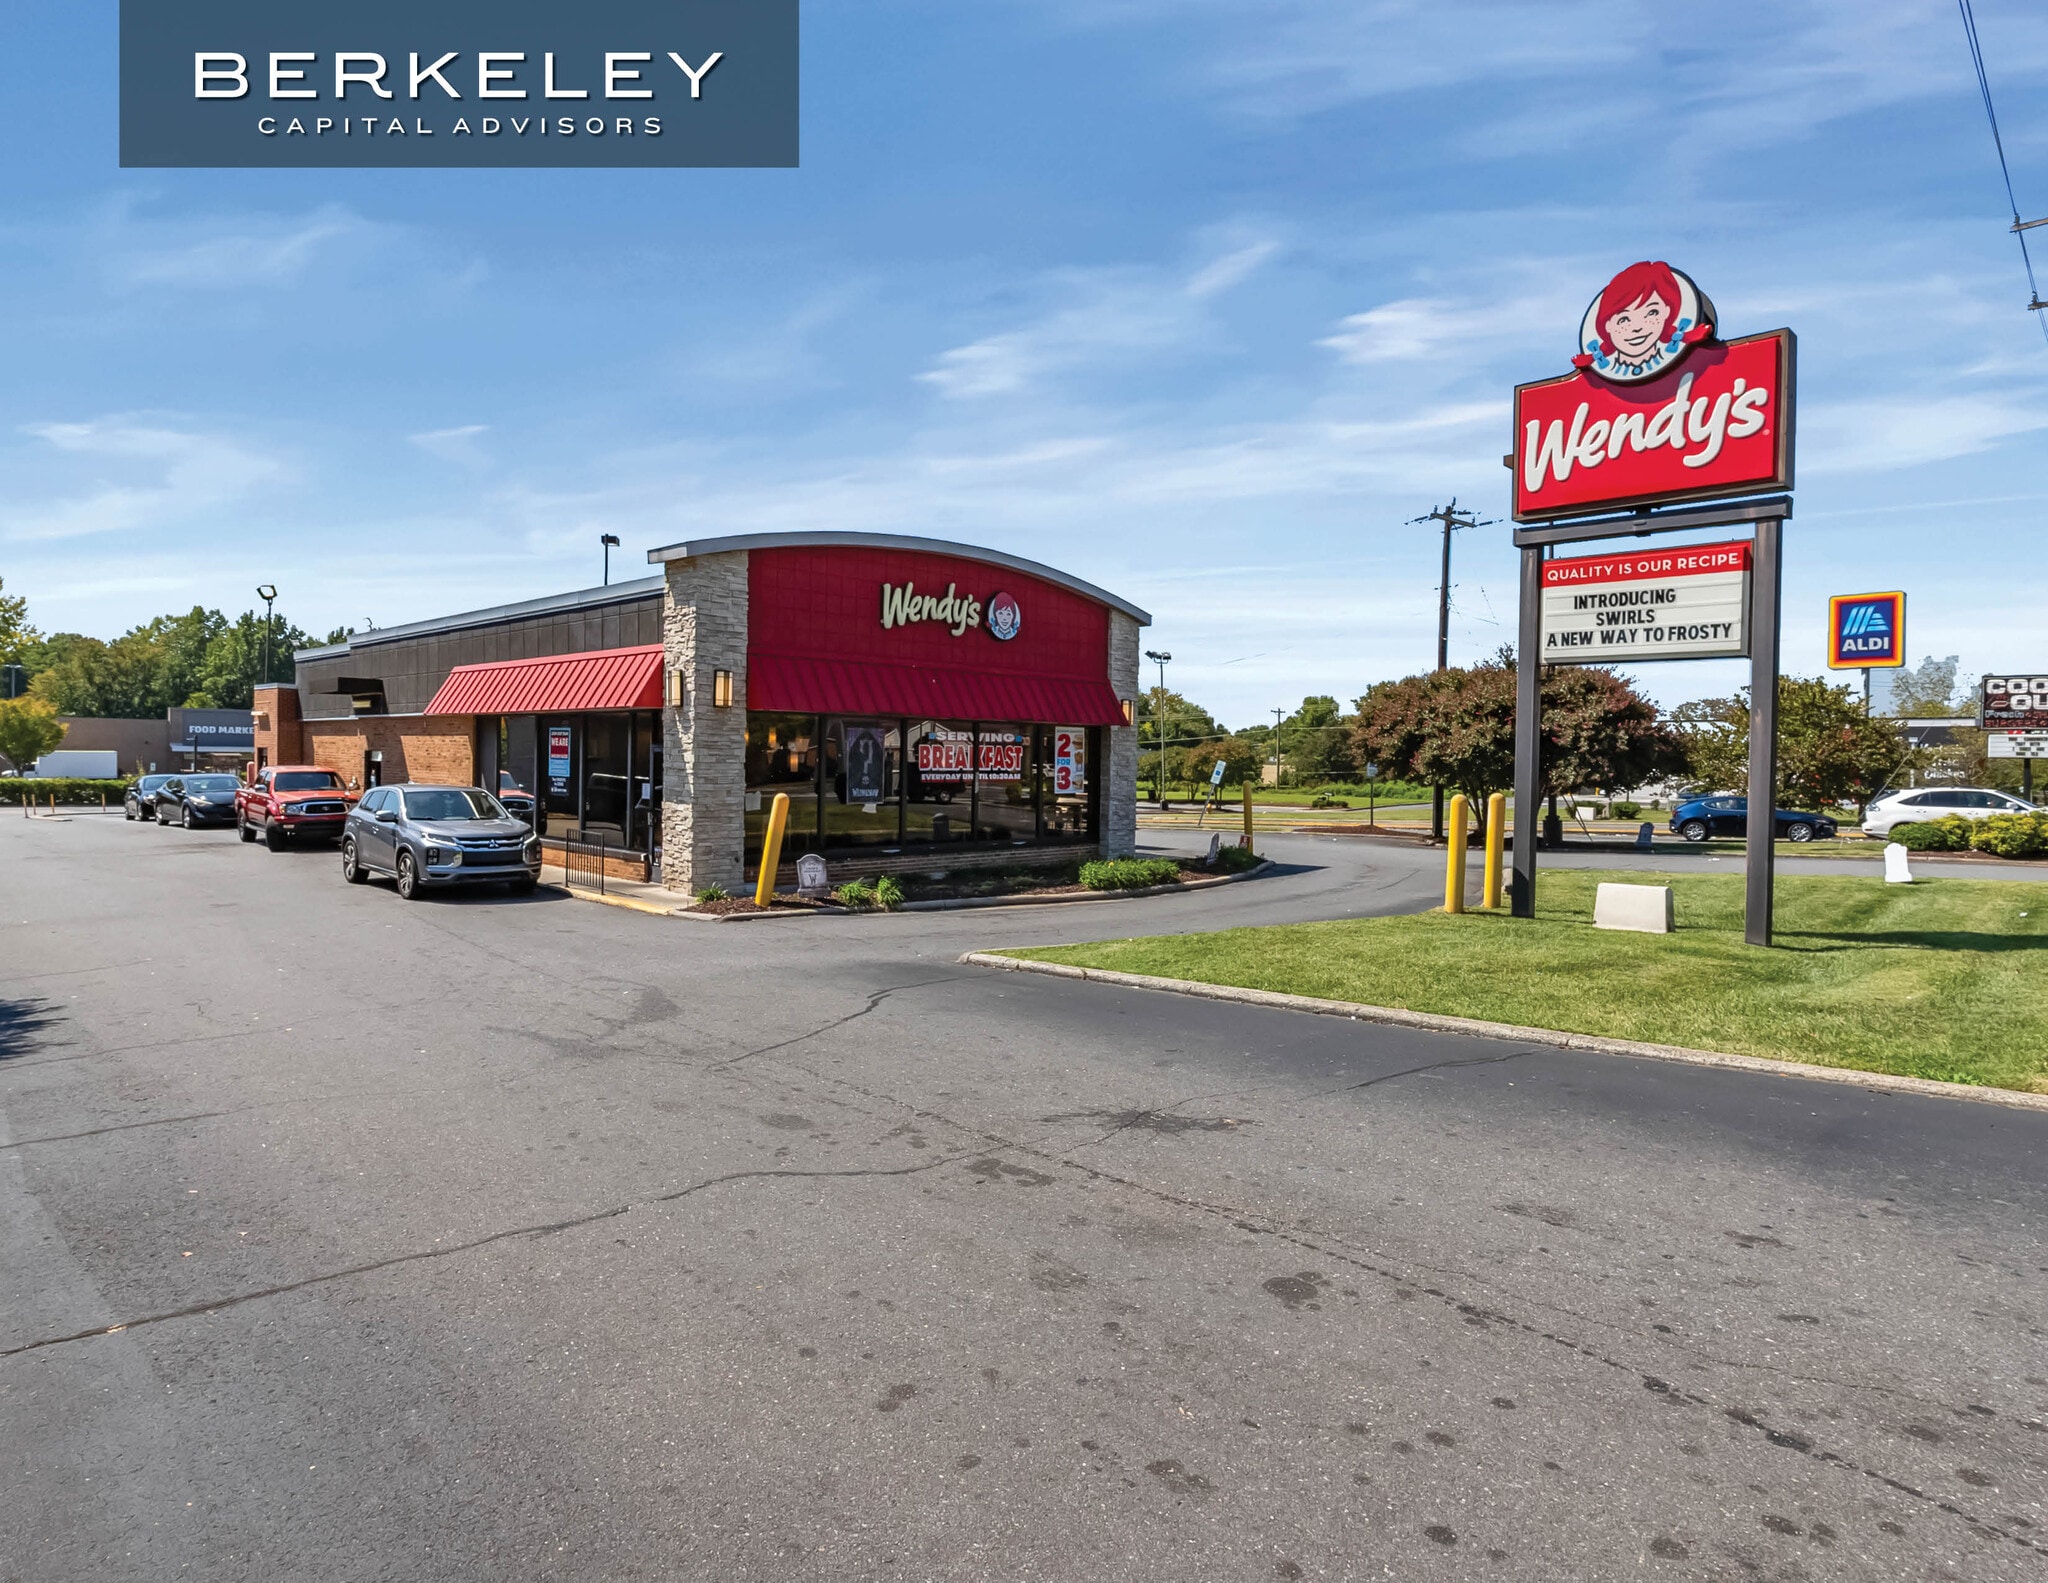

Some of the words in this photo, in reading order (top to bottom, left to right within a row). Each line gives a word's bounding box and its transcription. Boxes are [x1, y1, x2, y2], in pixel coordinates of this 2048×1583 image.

[1524, 371, 1768, 493] Wendy's
[1547, 564, 1614, 581] QUALITY
[1619, 562, 1632, 575] IS
[1637, 558, 1671, 572] OUR
[1677, 552, 1739, 570] RECIPE
[883, 581, 981, 637] Wendy's
[1574, 588, 1676, 610] INTRODUCING
[1596, 609, 1655, 626] SWIRLS
[1547, 633, 1557, 647] A
[1561, 631, 1593, 647] NEW
[1600, 628, 1638, 645] WAY
[1643, 627, 1664, 642] TO
[1668, 622, 1732, 641] FROSTY
[1841, 636, 1890, 652] ALDI
[1986, 679, 2048, 694] COO
[2010, 694, 2048, 710] OU
[189, 725, 217, 734] FOOD
[218, 726, 254, 735] MARKE
[936, 731, 1015, 742] SERVING
[1057, 733, 1071, 758] 2
[918, 744, 1023, 771] BREAKFAST
